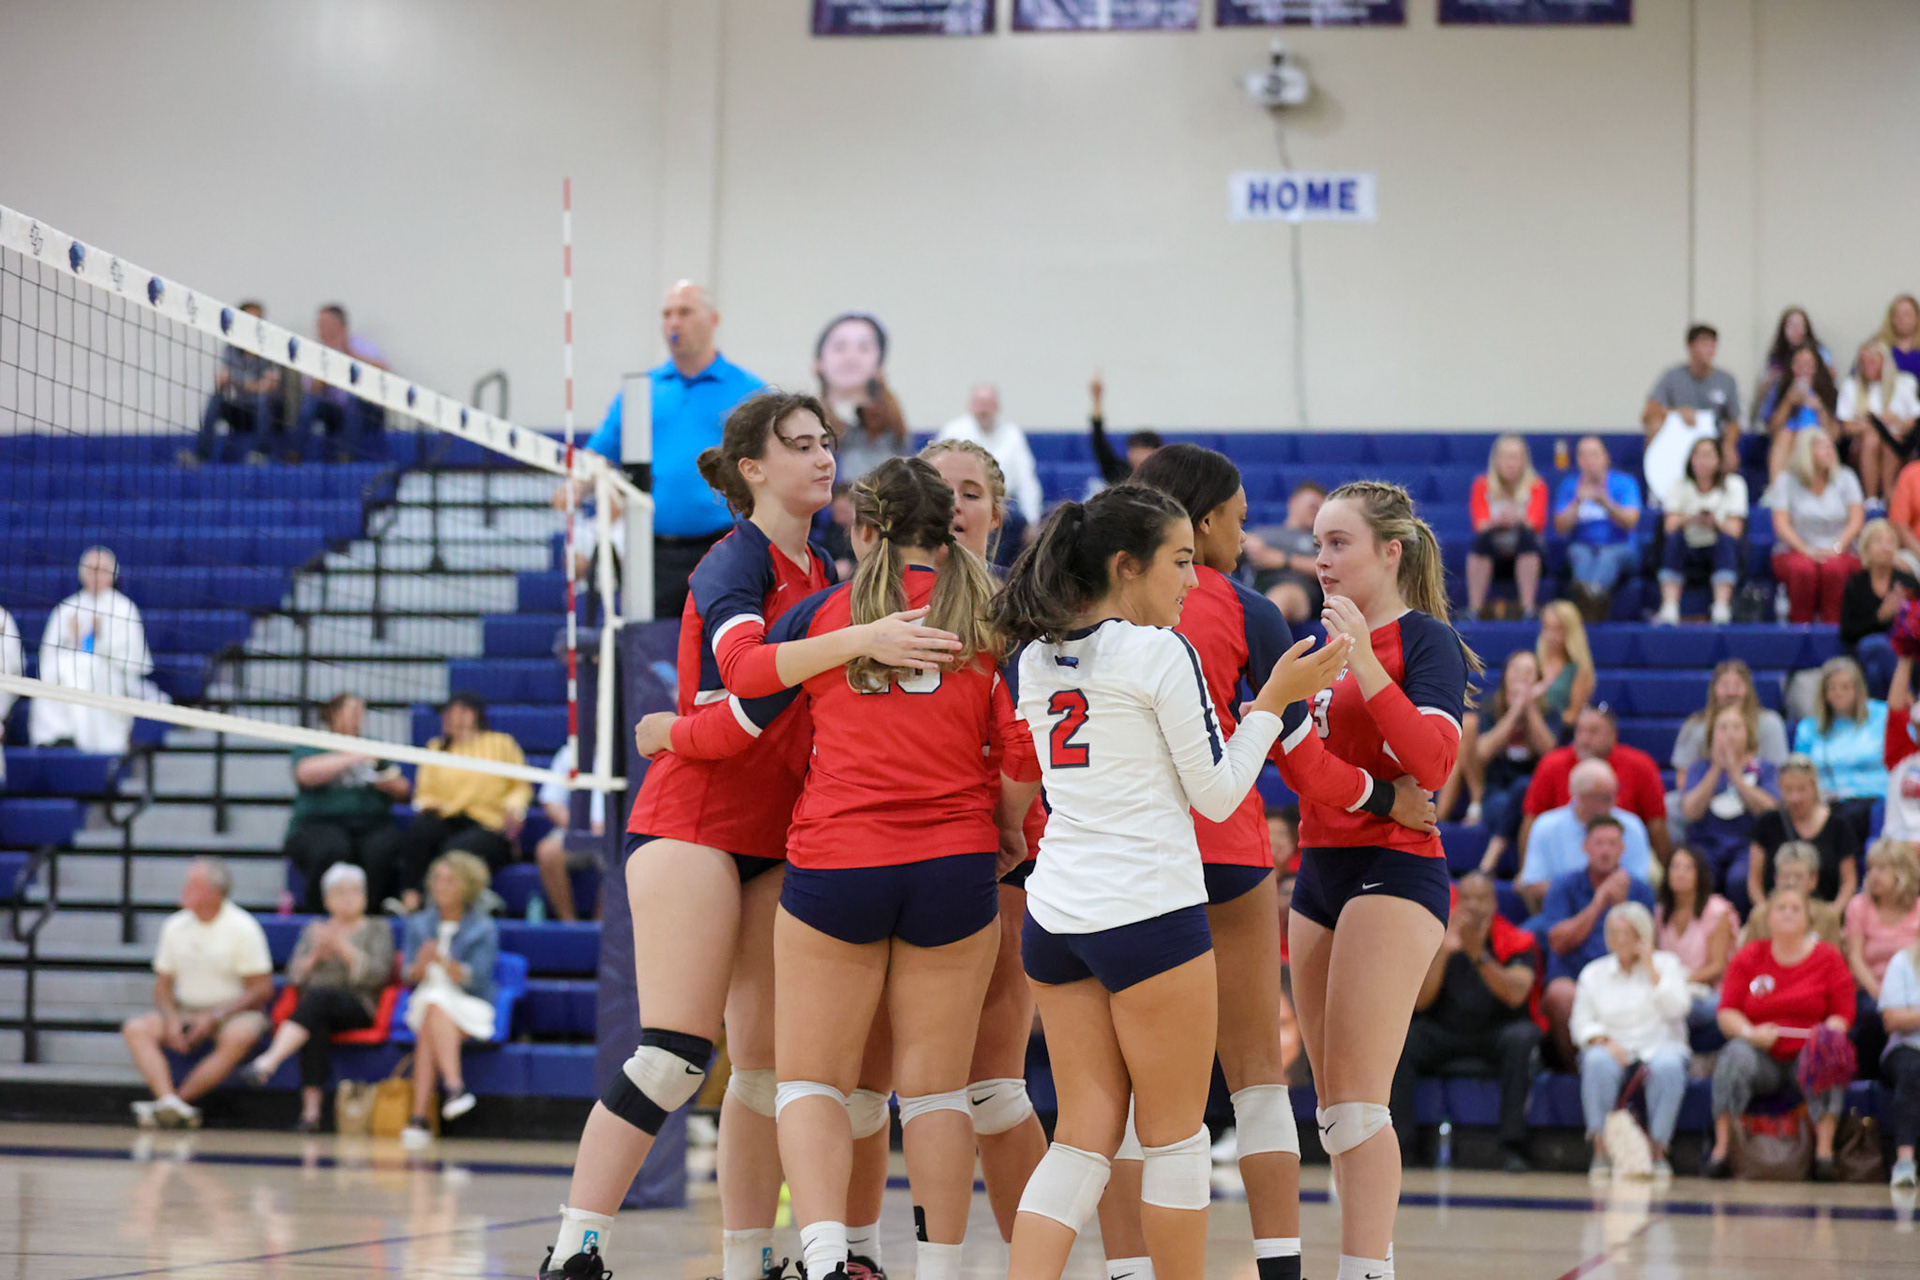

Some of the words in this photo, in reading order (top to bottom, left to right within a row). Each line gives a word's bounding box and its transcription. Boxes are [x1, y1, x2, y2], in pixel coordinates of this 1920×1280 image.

[1248, 180, 1357, 212] HOME
[1047, 688, 1090, 770] 2
[1312, 687, 1334, 739] 3
